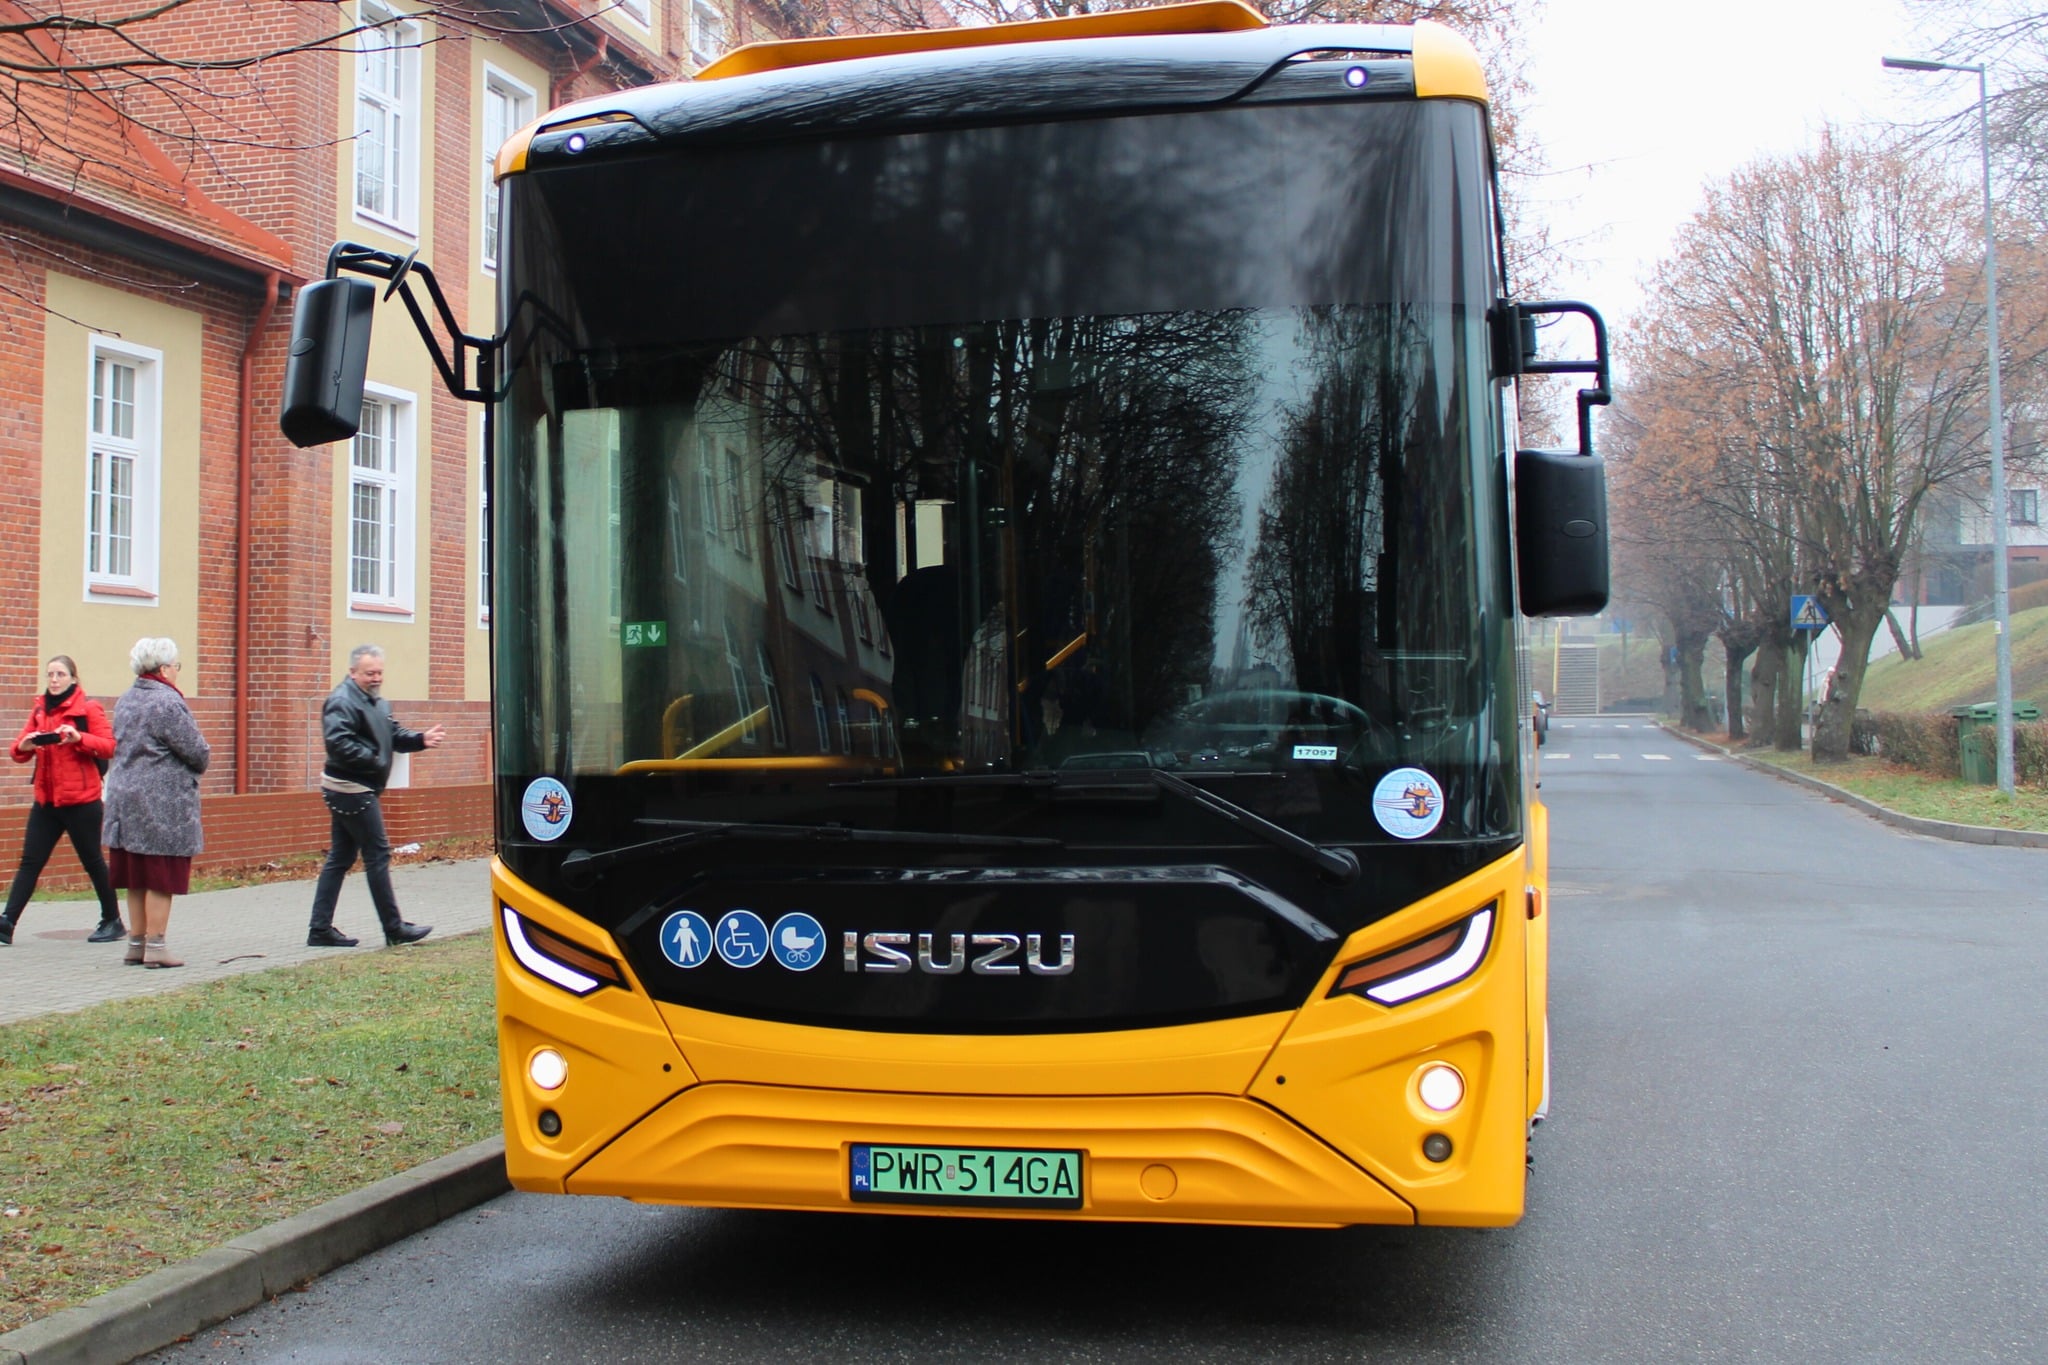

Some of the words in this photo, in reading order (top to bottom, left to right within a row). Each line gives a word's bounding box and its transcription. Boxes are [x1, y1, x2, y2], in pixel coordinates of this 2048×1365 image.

[843, 931, 1075, 976] ISUZU
[855, 1174, 869, 1187] PL
[872, 1151, 943, 1191] PWR
[958, 1154, 1075, 1196] 514GA
